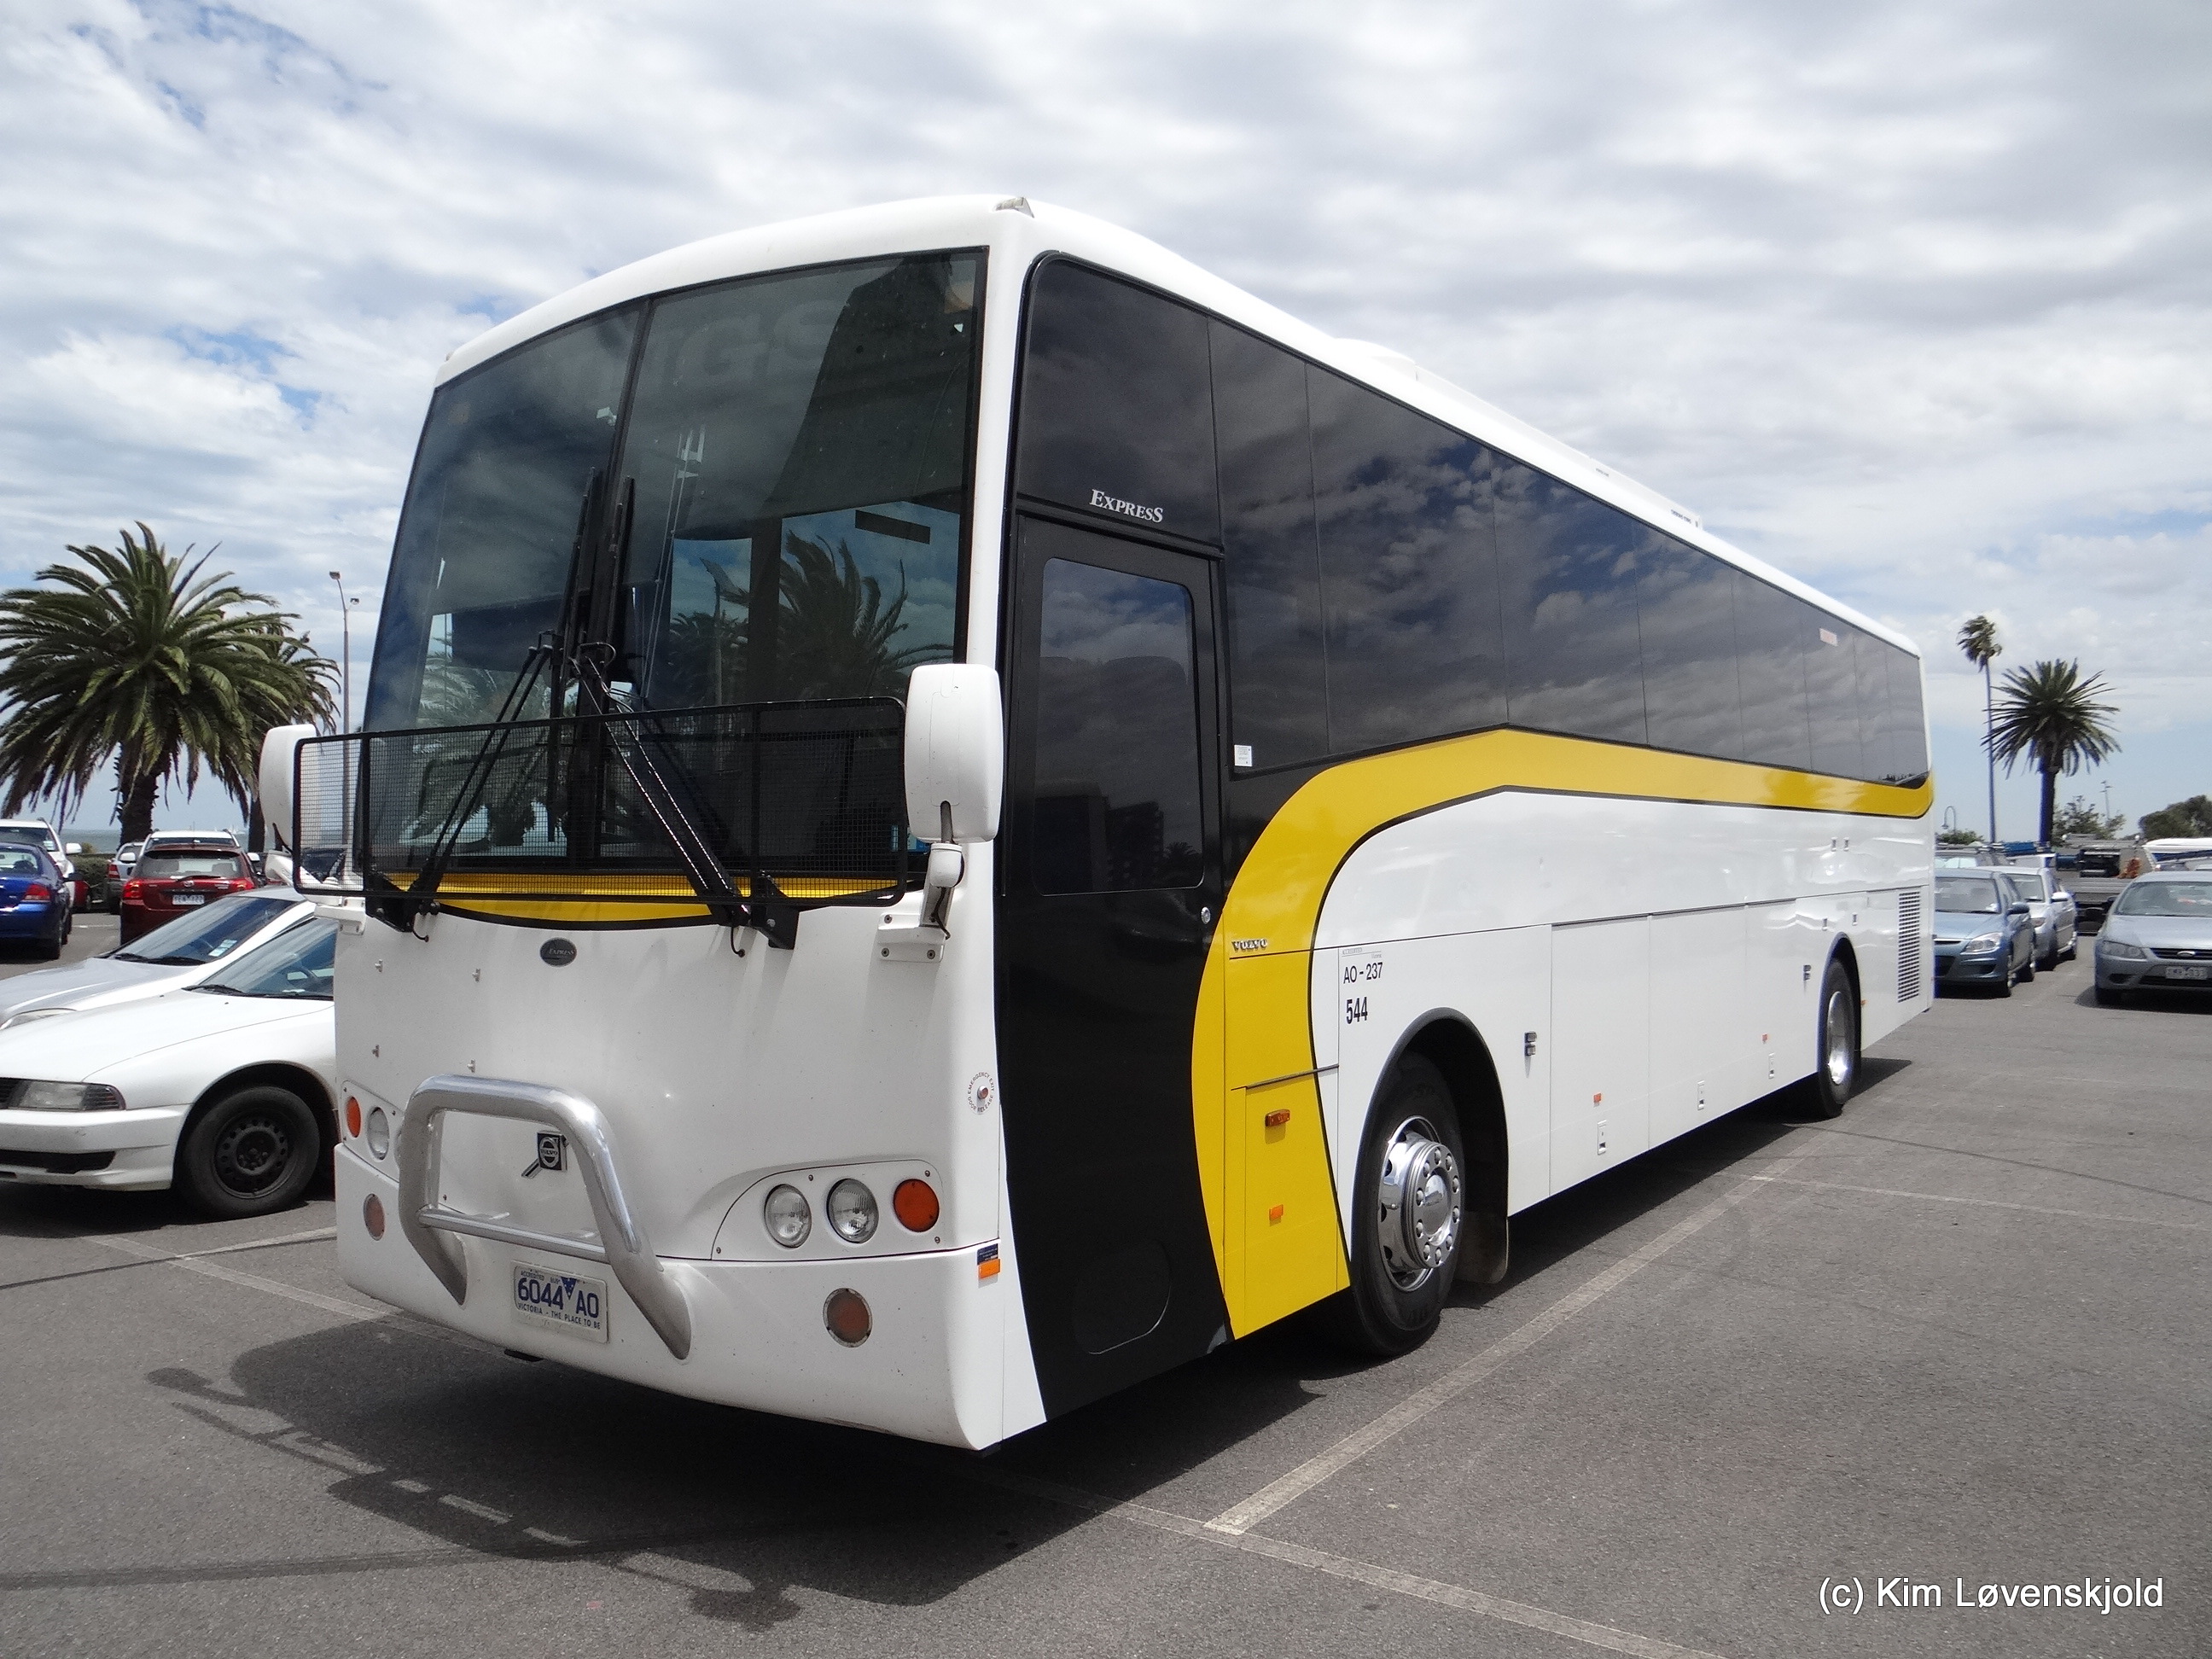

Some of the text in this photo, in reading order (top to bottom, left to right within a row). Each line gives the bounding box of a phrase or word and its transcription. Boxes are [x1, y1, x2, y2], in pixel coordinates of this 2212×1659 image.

[1089, 489, 1164, 523] EXPRESS
[1231, 939, 1268, 952] VOLVO
[1343, 965, 1357, 984] AO
[1366, 962, 1383, 981] 237
[1346, 996, 1368, 1024] 544
[968, 1072, 990, 1094] EMERGENCY
[968, 1094, 994, 1113] DOOR RELEASE
[518, 1278, 563, 1310] 6044
[517, 1302, 543, 1315] VICTORIA
[551, 1311, 562, 1319] THE
[564, 1313, 582, 1324] PLACE
